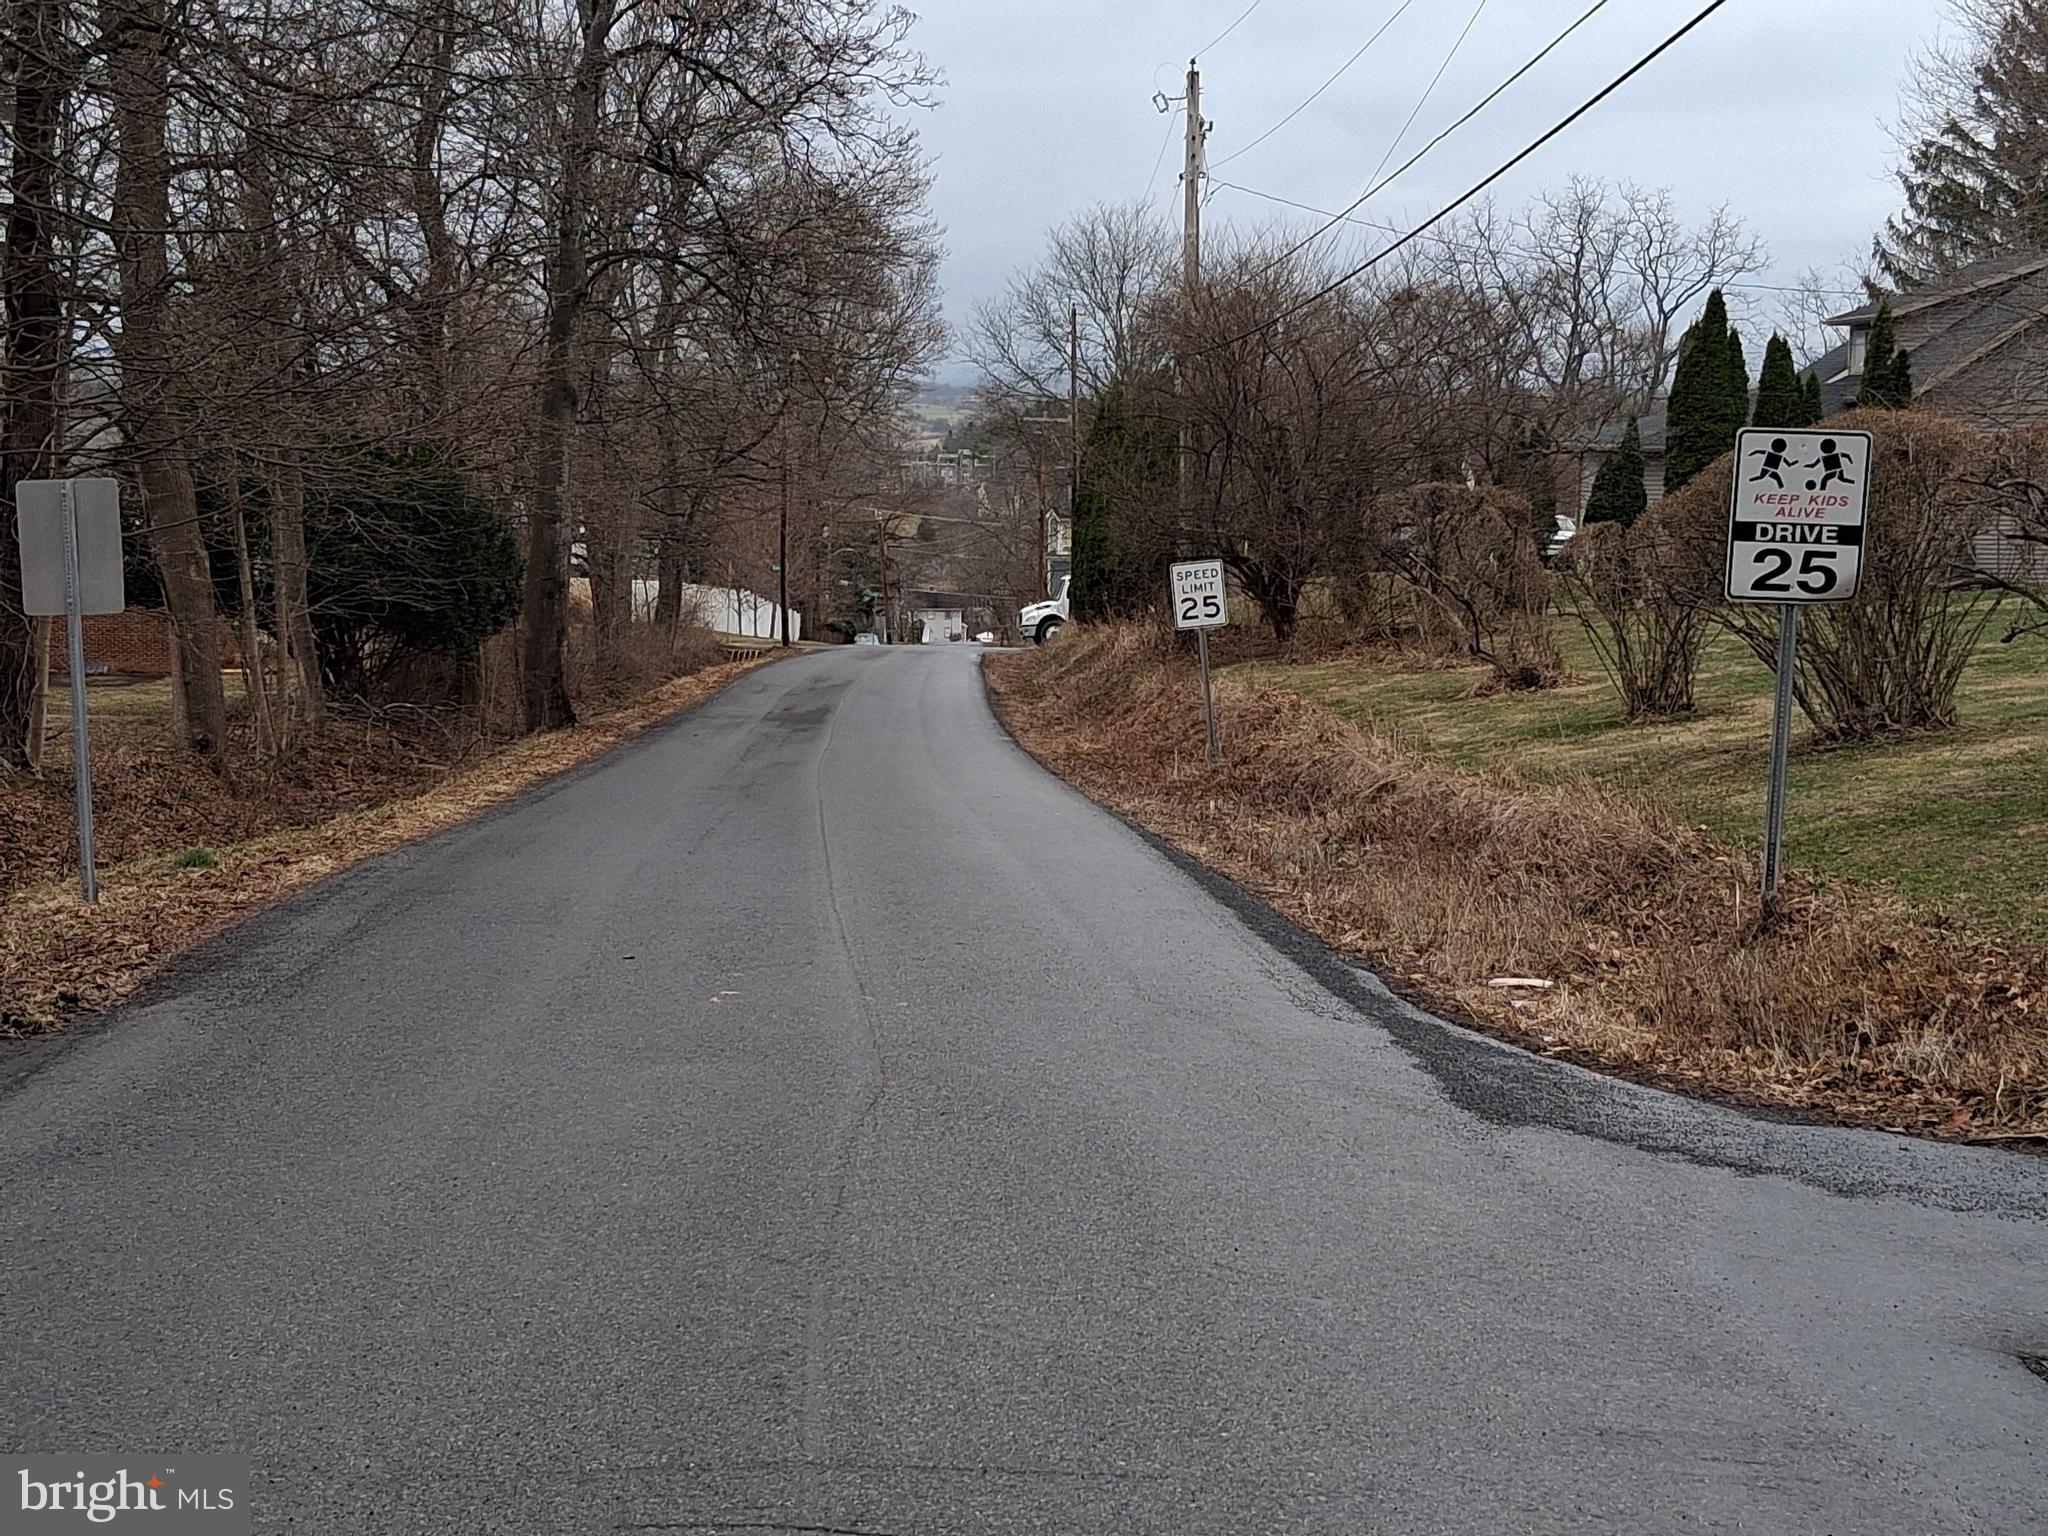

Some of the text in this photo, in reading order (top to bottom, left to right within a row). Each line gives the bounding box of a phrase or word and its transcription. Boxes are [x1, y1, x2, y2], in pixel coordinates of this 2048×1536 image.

[1754, 493, 1849, 507] KEEP KIDS
[1775, 507, 1828, 519] ALIVE
[1755, 523, 1839, 543] DRIVE
[1176, 568, 1218, 581] SPEED
[1750, 548, 1837, 594] 25
[1182, 582, 1214, 594] LIMIT
[1181, 595, 1220, 620] 25
